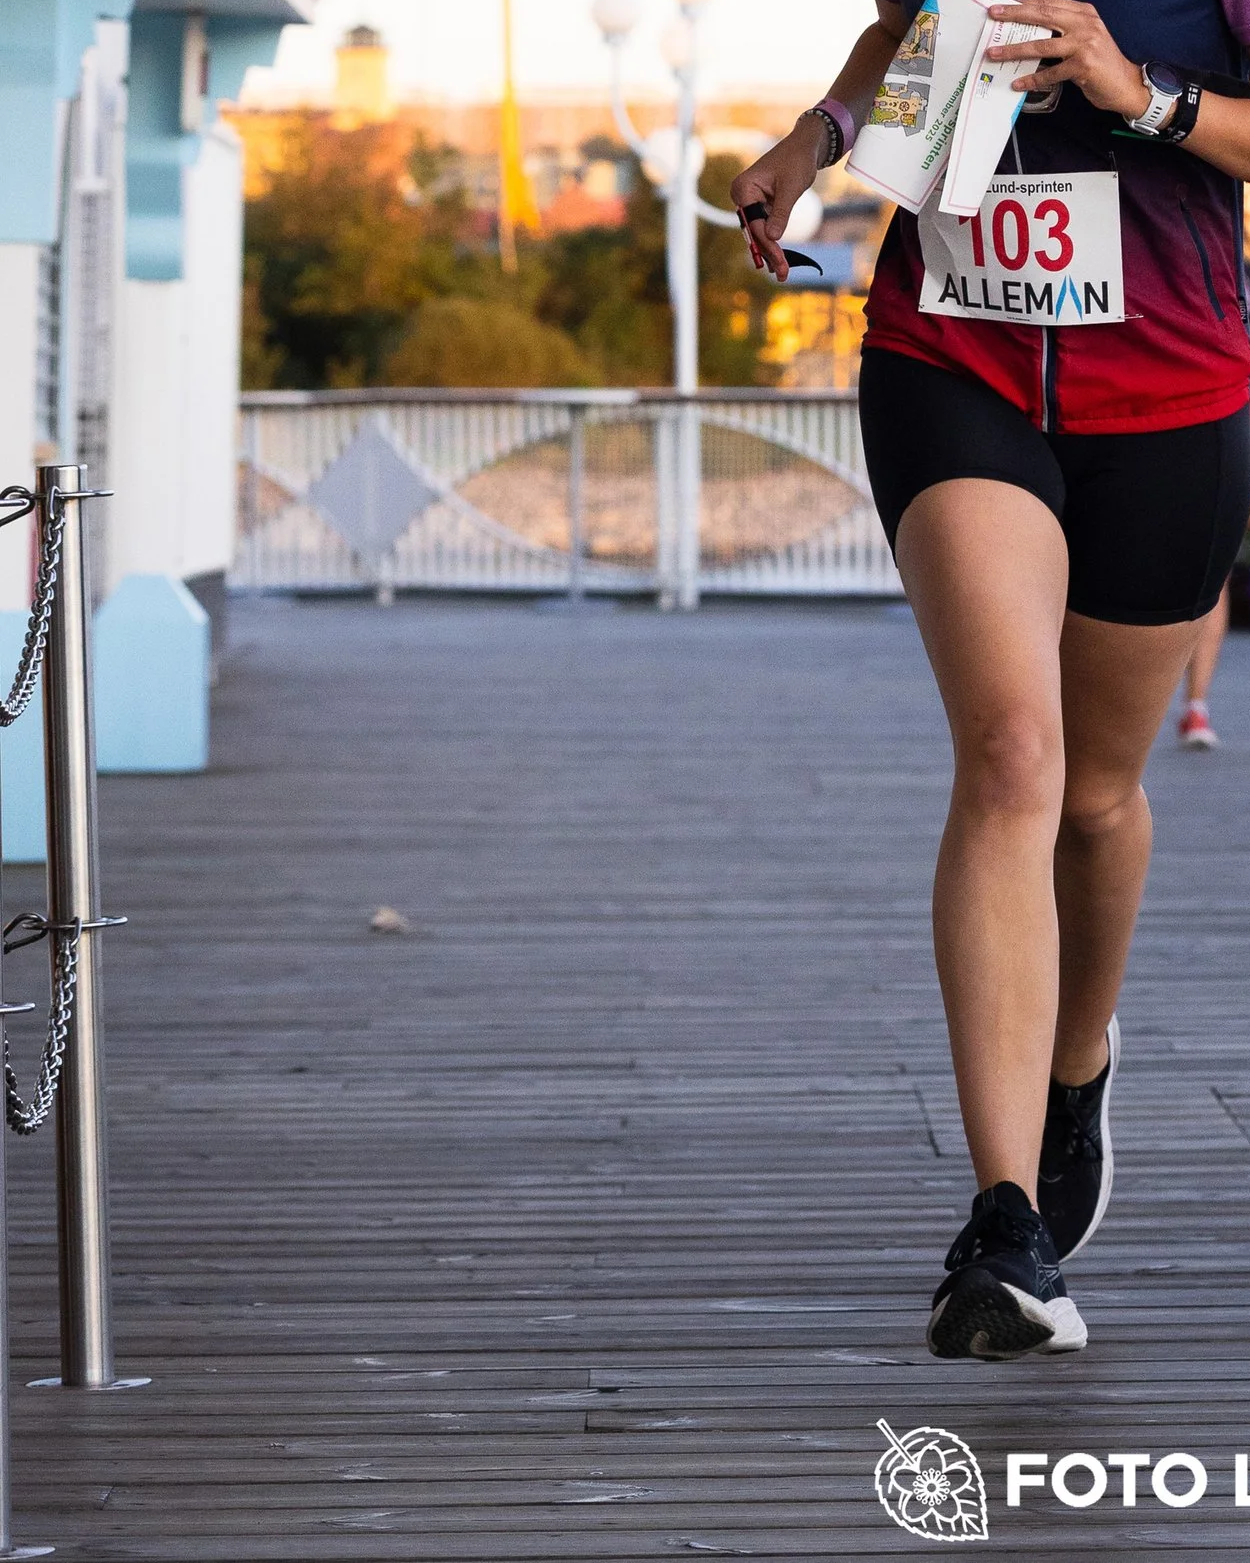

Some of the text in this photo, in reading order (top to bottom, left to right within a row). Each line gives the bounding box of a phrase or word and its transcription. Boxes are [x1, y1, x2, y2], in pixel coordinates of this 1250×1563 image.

[925, 118, 943, 142] 2025
[986, 180, 1073, 197] und-sprinten
[958, 198, 1074, 272] 103
[938, 272, 1109, 323] ALLEMAN
